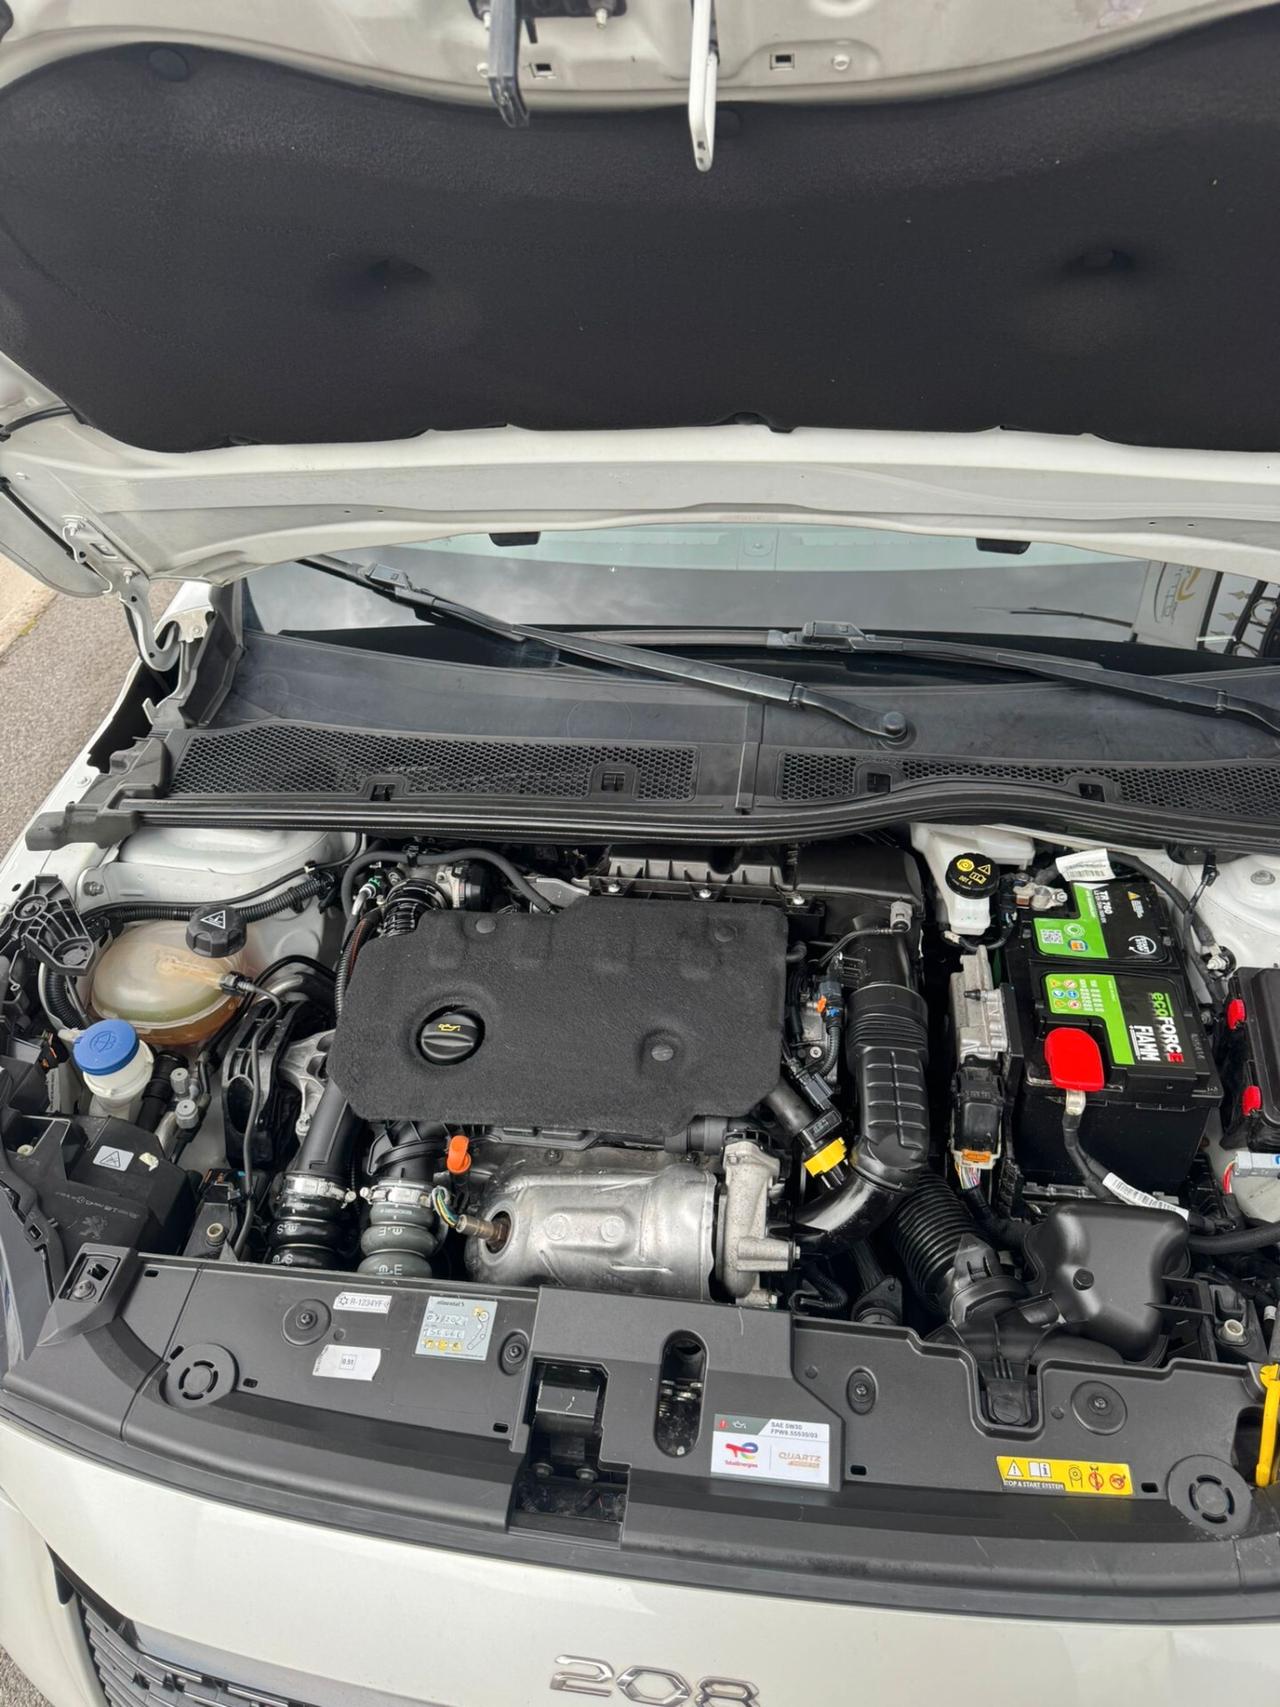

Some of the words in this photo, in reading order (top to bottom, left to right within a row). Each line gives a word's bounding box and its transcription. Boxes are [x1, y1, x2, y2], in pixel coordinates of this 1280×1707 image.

[1152, 992, 1184, 1064] ecoFORCE
[1133, 1025, 1161, 1062] FIAMM
[771, 1421, 784, 1429] SAE
[725, 1460, 758, 1468] TotalEnergies
[778, 1451, 821, 1462] QUARTZ
[550, 1654, 761, 1707] 208
